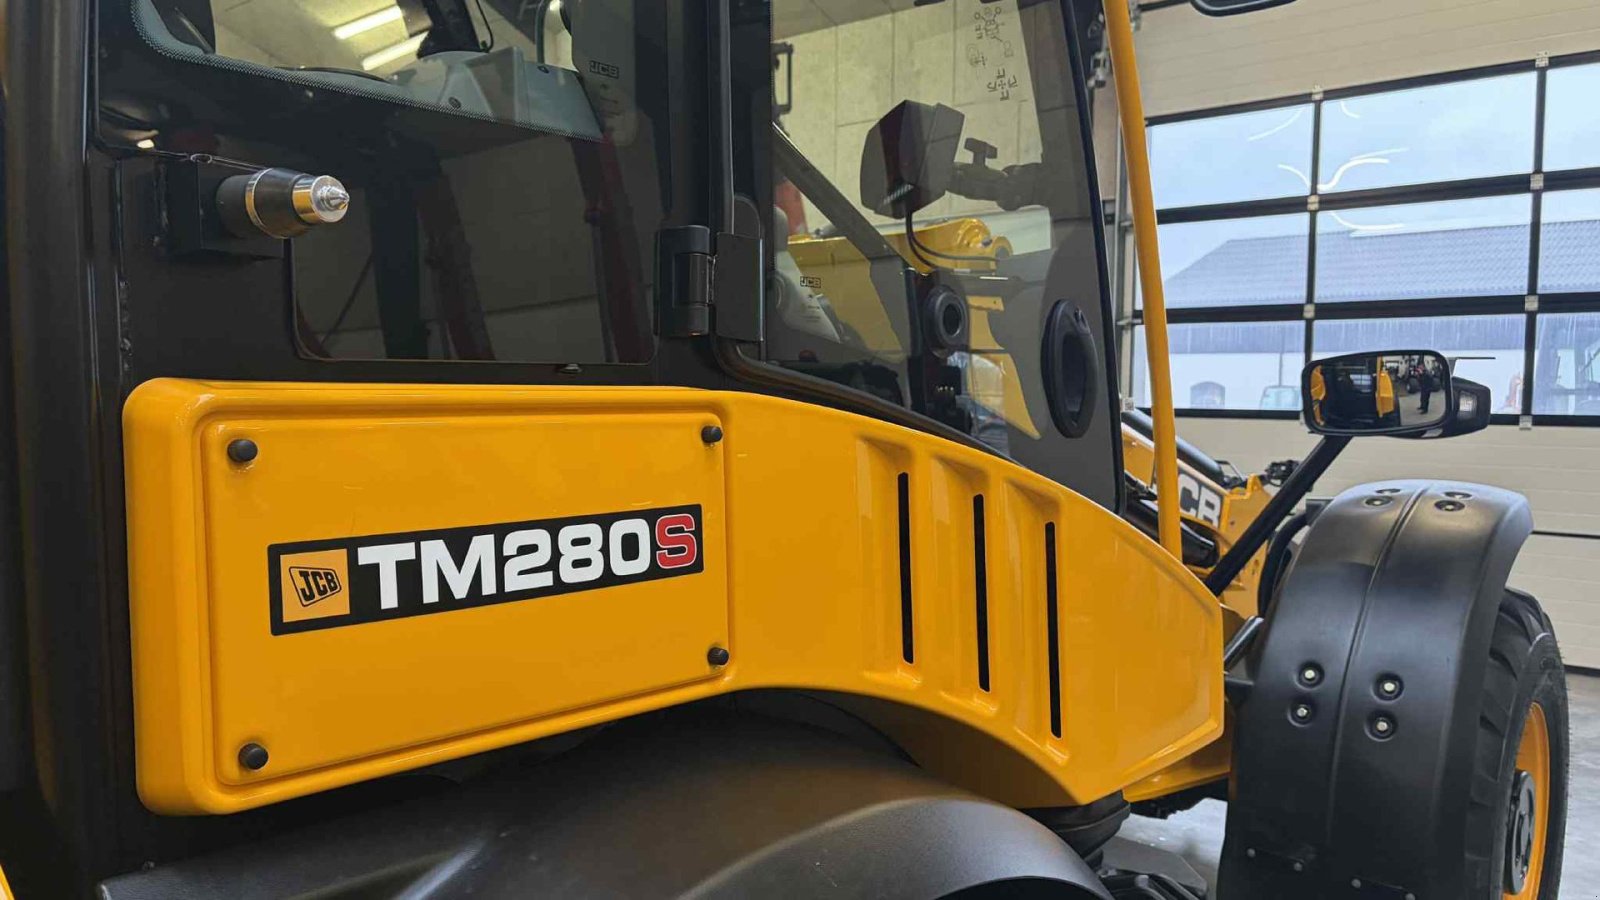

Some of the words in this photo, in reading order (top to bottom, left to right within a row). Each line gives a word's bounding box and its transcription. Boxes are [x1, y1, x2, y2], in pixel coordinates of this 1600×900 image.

[590, 61, 619, 78] JCB
[800, 276, 821, 288] JCB
[1153, 473, 1222, 529] CB
[357, 513, 697, 610] TM280S
[299, 570, 337, 601] JCB
